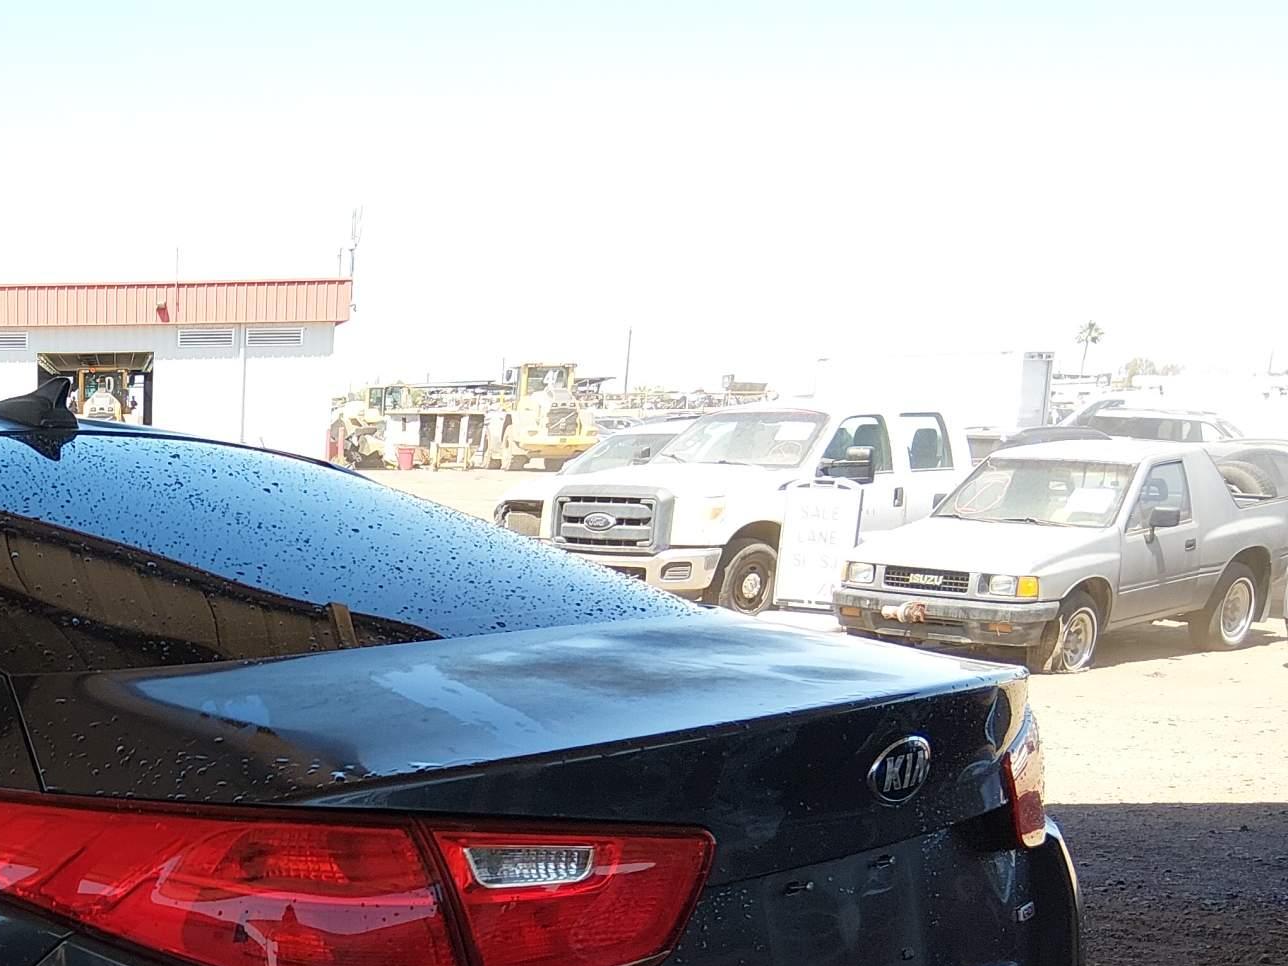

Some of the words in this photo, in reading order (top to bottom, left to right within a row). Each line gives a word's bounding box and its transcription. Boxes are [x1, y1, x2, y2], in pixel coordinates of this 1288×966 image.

[799, 503, 840, 520] SALE
[797, 528, 840, 545] LANE
[908, 573, 943, 586] ISUZU
[883, 750, 925, 792] KIA
